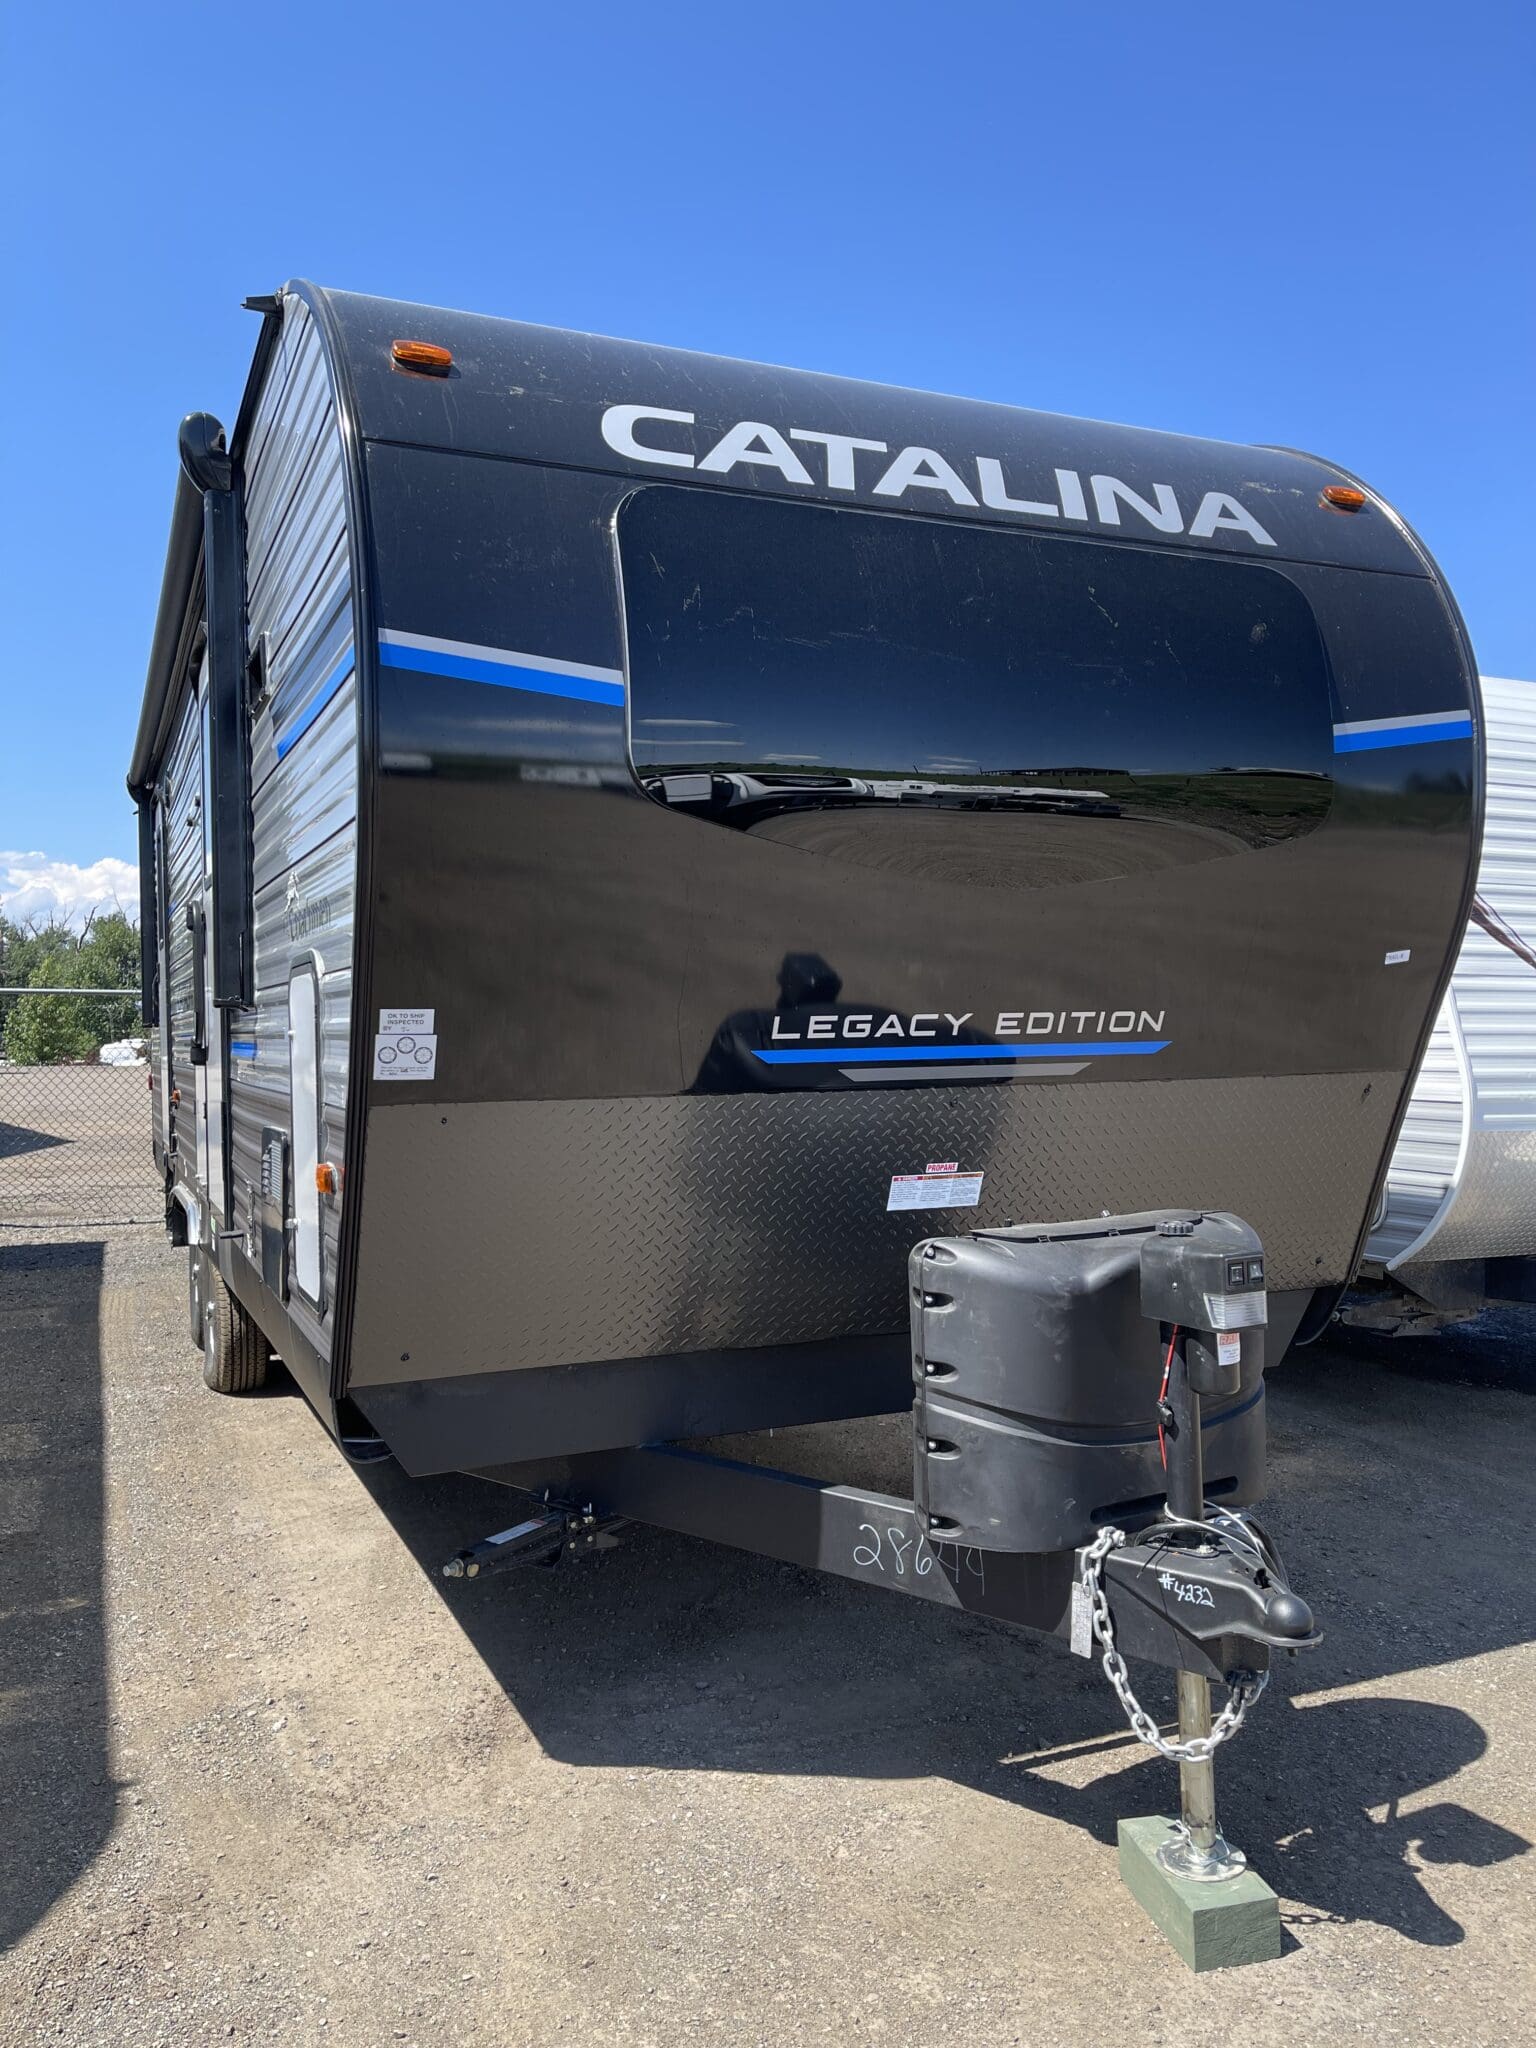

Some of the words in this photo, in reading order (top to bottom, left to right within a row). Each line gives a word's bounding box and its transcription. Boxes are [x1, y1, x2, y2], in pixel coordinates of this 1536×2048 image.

[600, 404, 1278, 547] CATALINA
[771, 1012, 973, 1040] LEGACY
[994, 1010, 1165, 1035] EDITION
[927, 1163, 957, 1172] PROPANE
[1157, 1572, 1216, 1609] #4232
